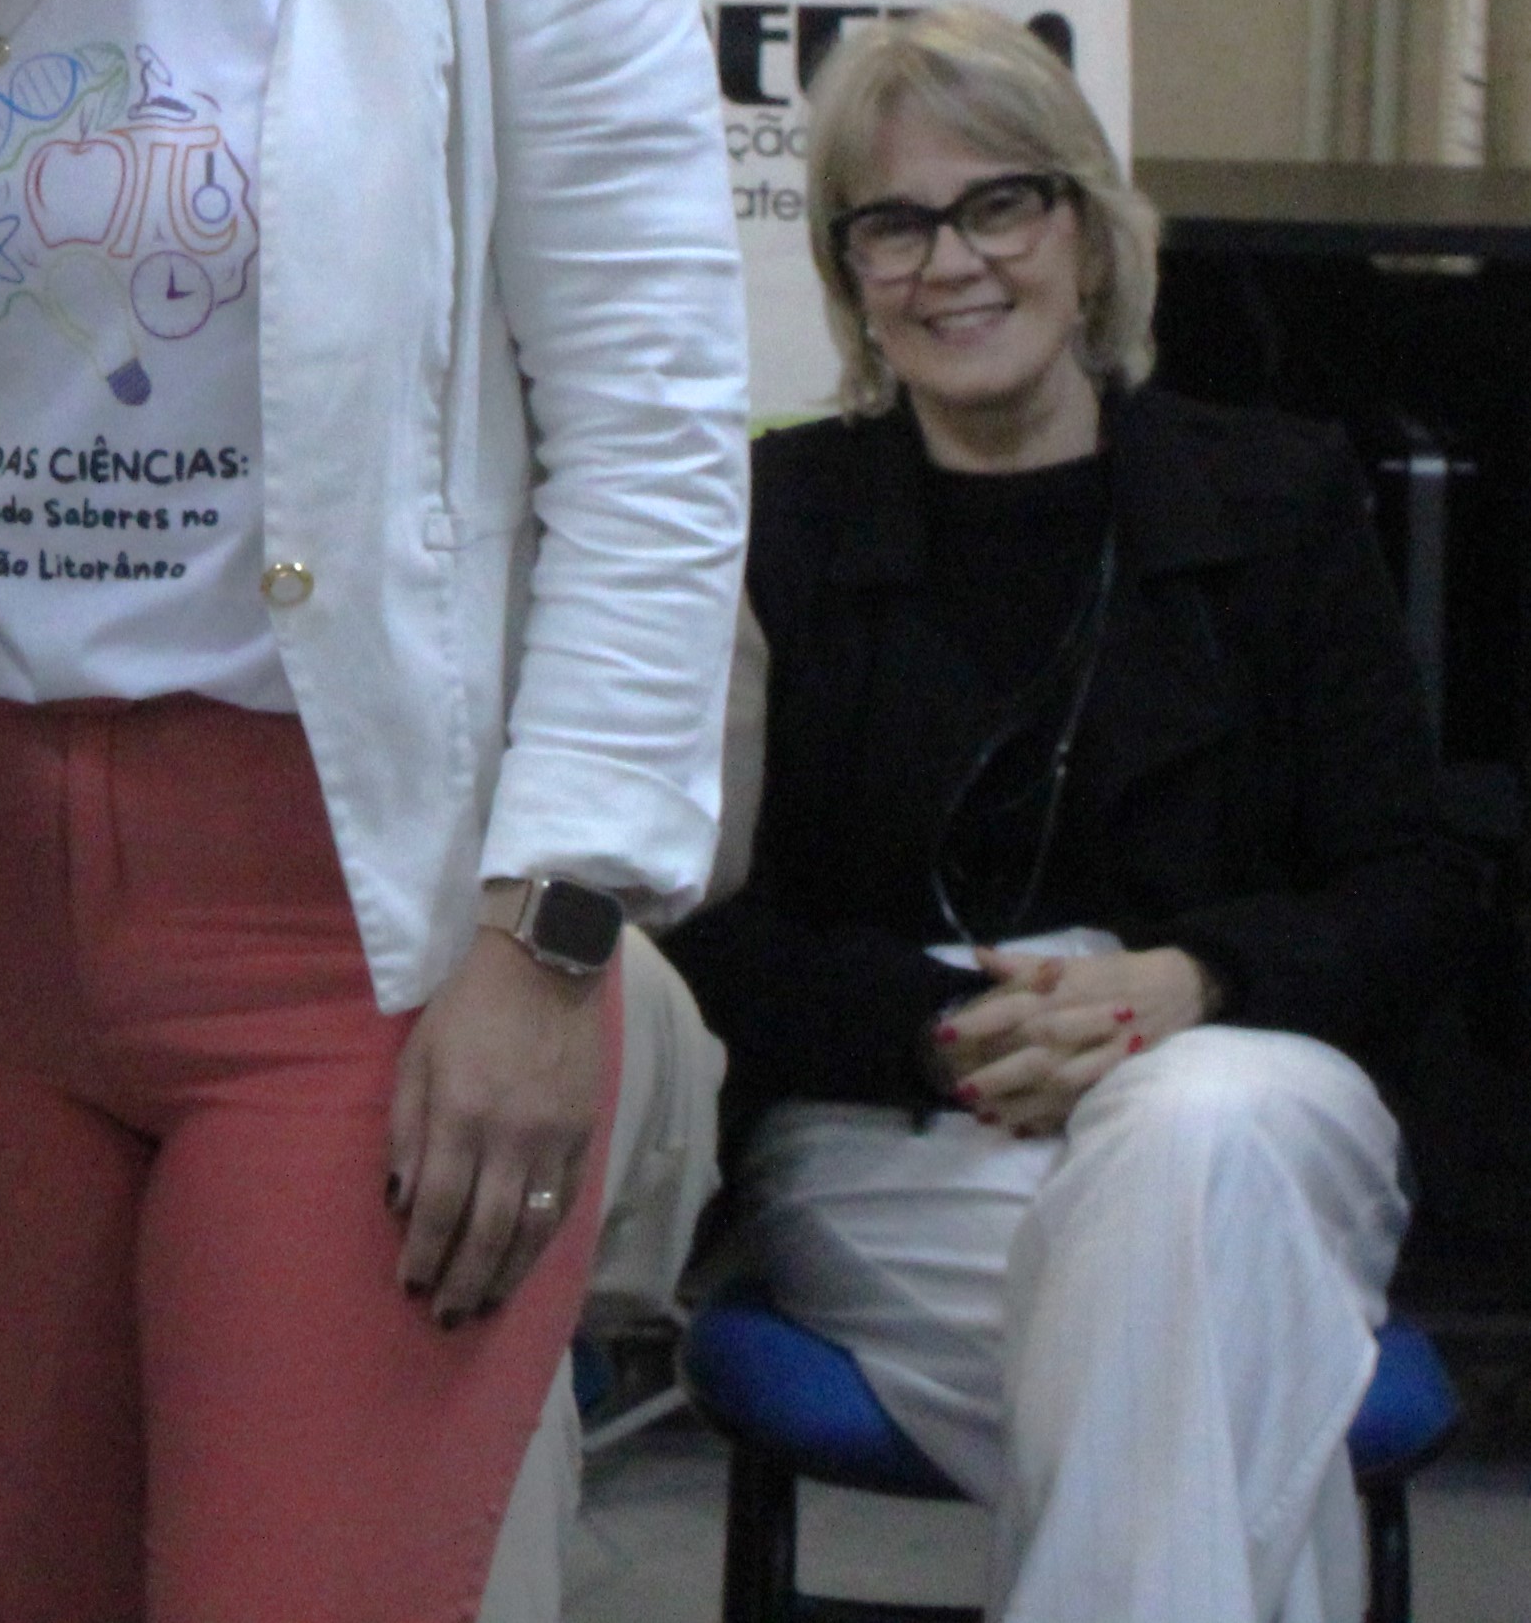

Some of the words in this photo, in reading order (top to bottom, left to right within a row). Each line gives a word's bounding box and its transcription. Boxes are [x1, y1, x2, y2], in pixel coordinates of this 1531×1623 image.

[48, 433, 250, 485] CIÊNCIAS:
[43, 497, 171, 530] Saberes
[181, 505, 220, 529] no
[38, 548, 187, 581] Litorâneo
